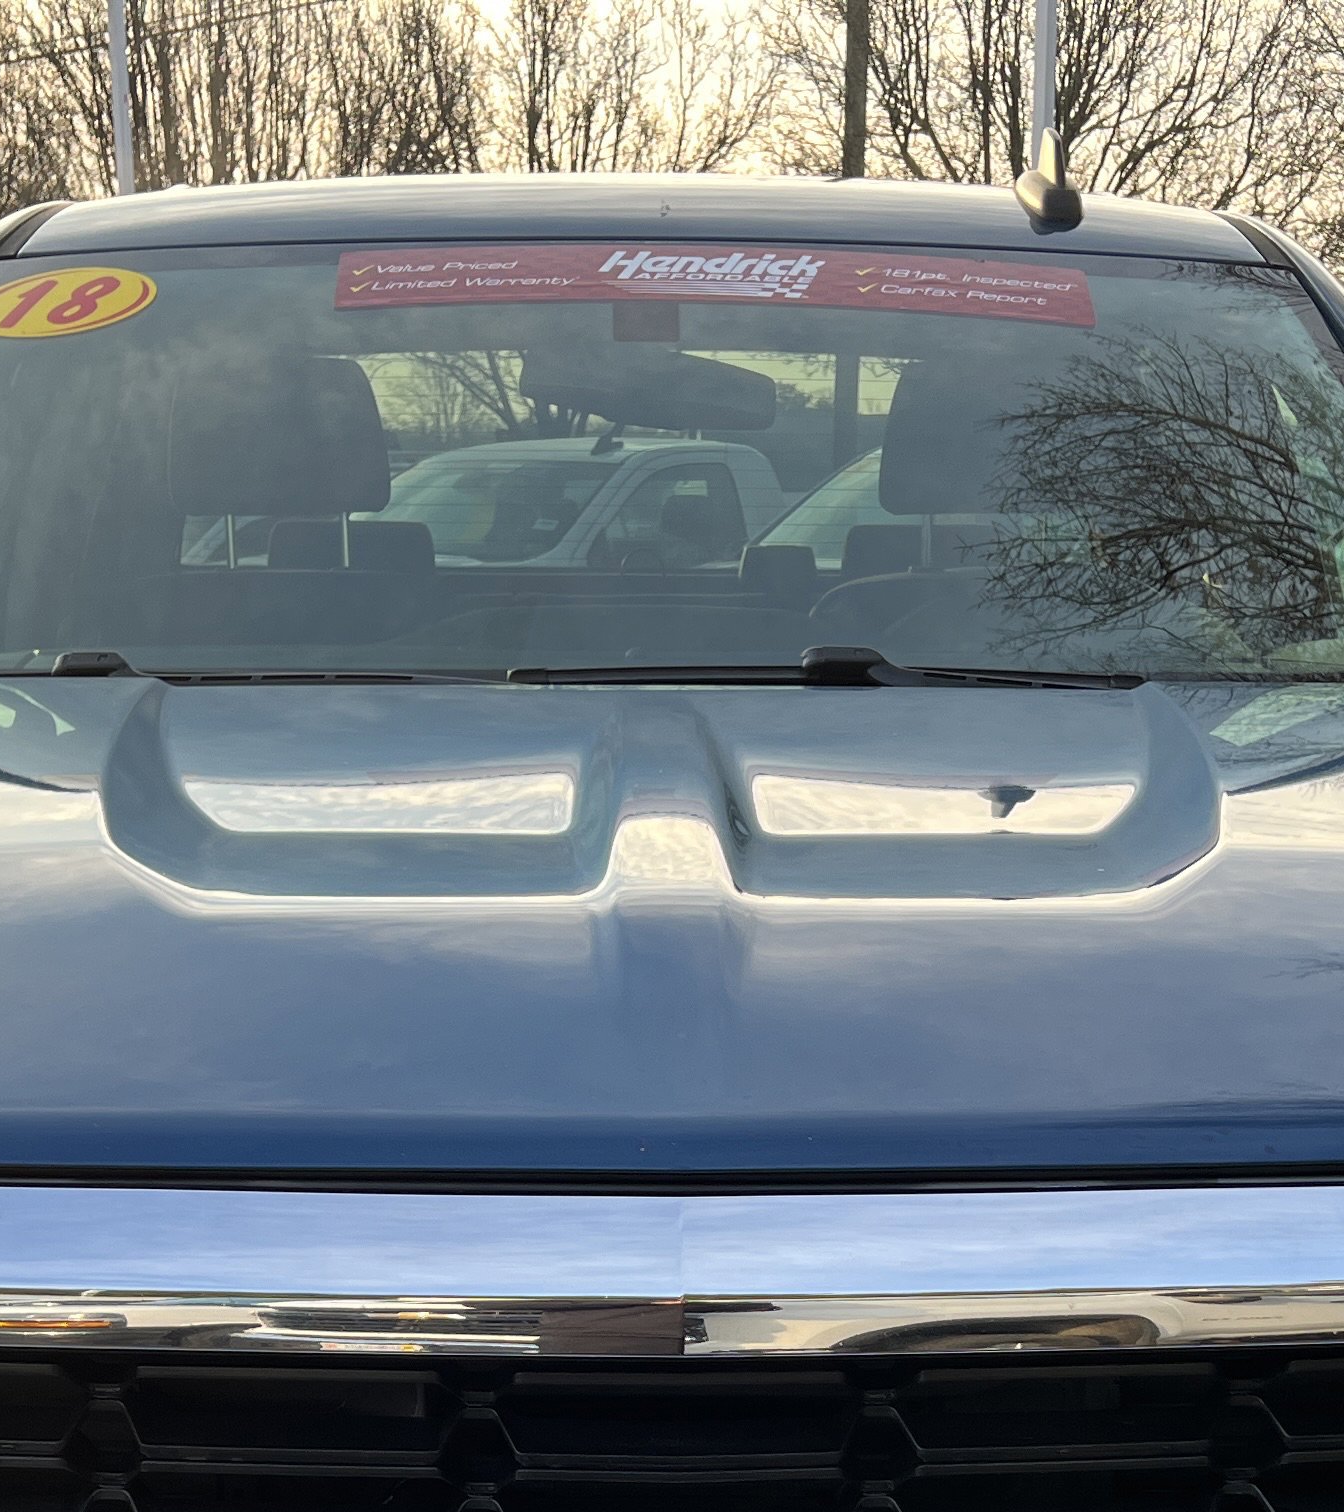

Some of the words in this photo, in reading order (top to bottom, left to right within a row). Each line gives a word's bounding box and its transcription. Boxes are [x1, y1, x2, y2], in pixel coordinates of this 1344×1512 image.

[377, 263, 435, 274] Value
[443, 260, 518, 271] Priced
[598, 251, 826, 279] Hendrick
[371, 278, 457, 291] Limited
[465, 276, 576, 287] Warranty
[633, 272, 814, 283] AFFORDABLE
[962, 273, 1072, 291] Inspected
[880, 284, 957, 298] Carfax
[966, 290, 1047, 306] Report
